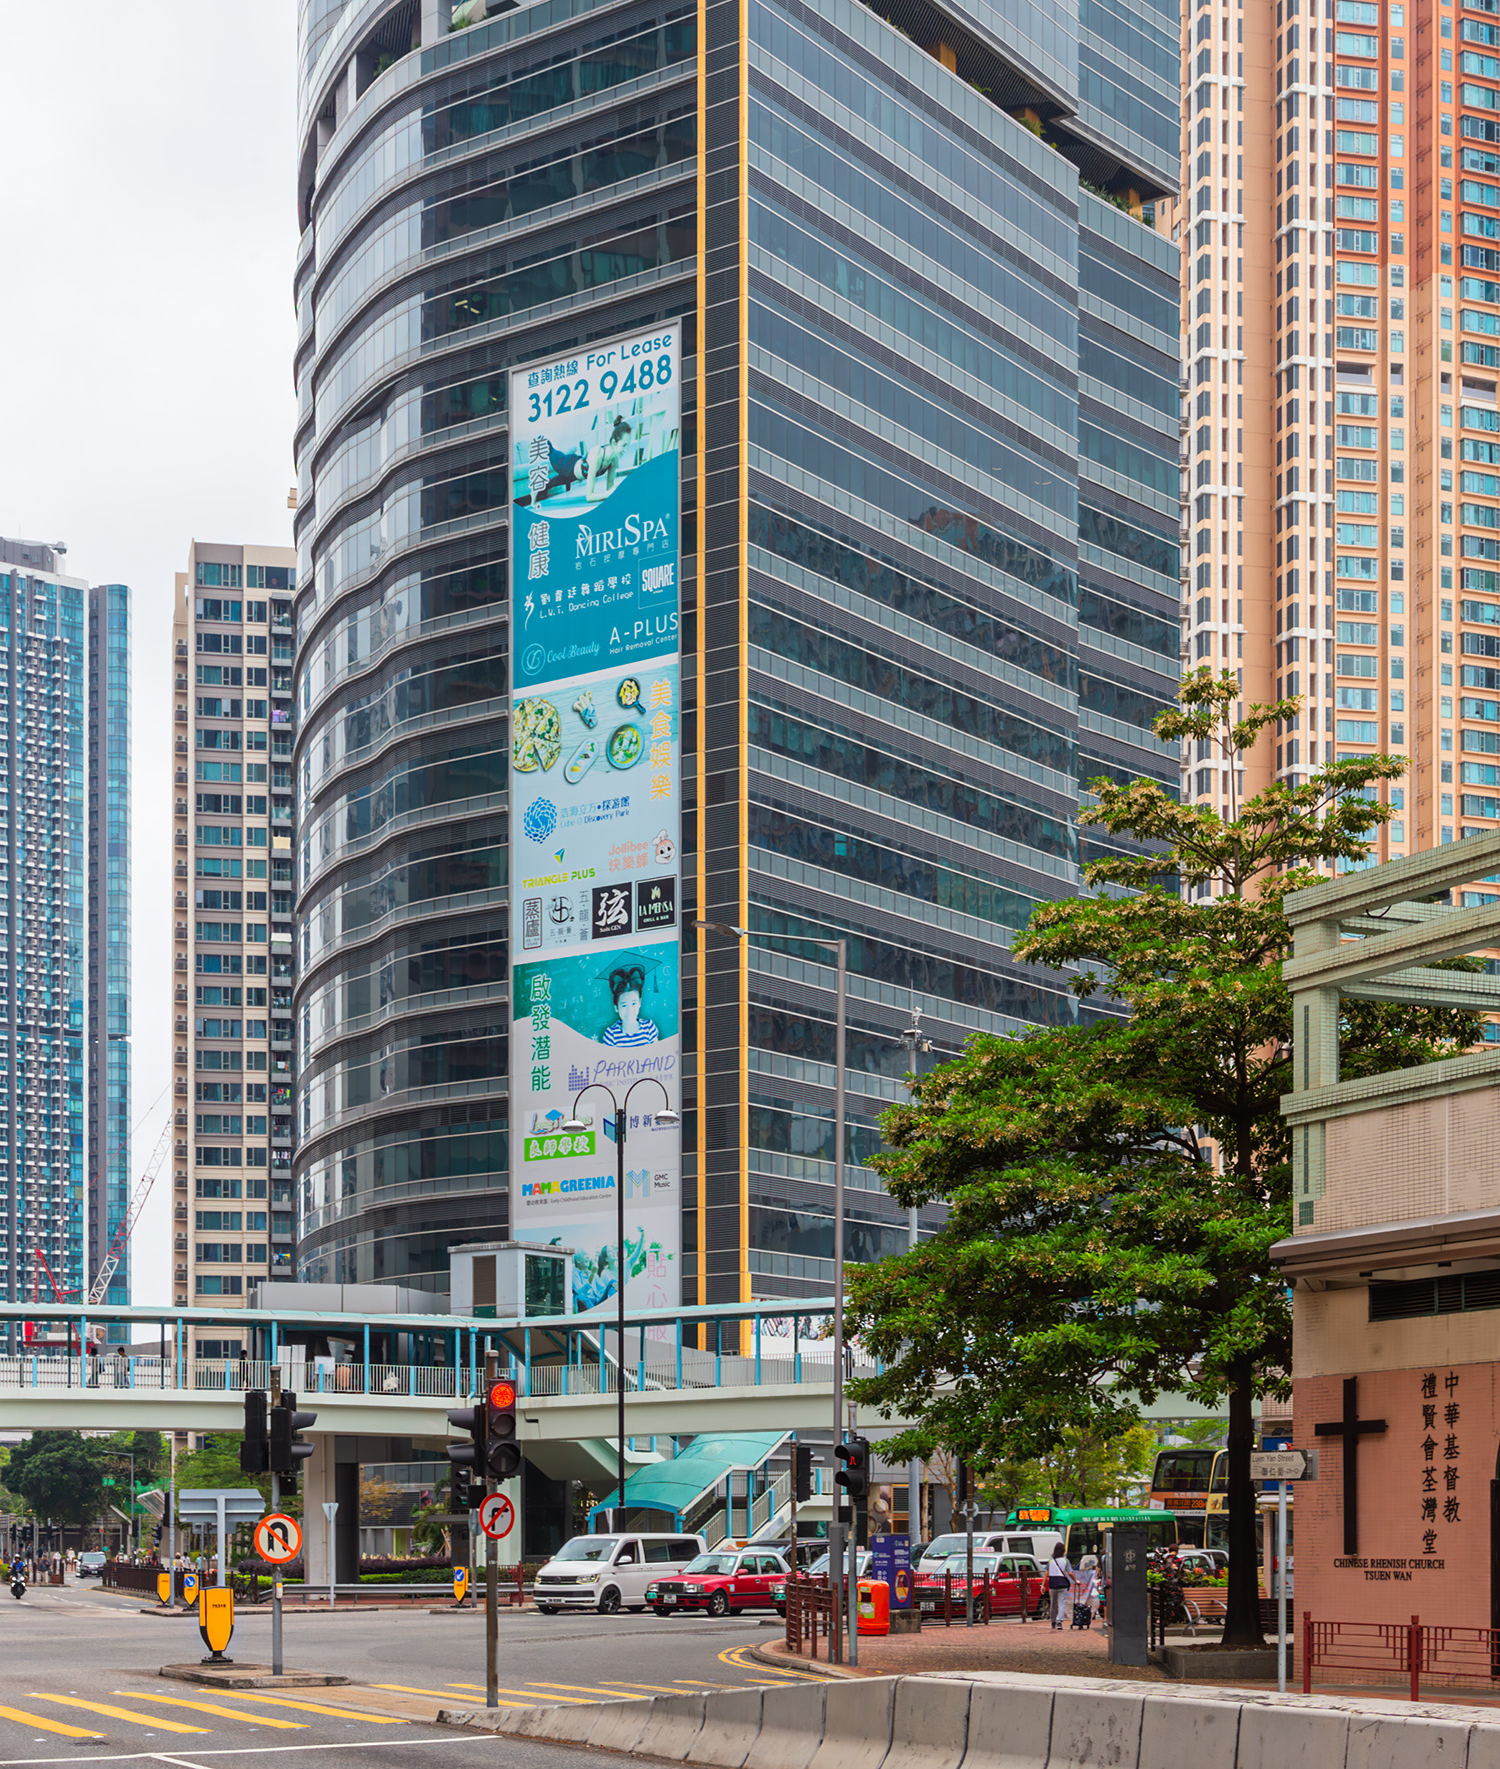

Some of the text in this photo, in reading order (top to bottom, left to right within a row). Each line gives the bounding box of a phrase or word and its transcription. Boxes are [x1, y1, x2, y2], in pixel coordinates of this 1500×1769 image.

[528, 334, 672, 388] 查詢熱線 For Lease
[528, 354, 672, 422] 3122 9488
[642, 563, 675, 592] SQUARE
[568, 599, 599, 612] Dancing
[602, 591, 634, 604] College
[609, 634, 678, 655] Hair Removal Center
[650, 678, 672, 801] 美食娛樂
[615, 808, 630, 818] Park
[608, 841, 649, 856] Jollibee
[608, 852, 649, 873] 快樂蜂
[522, 867, 596, 889] TRIANGLE PLUS
[594, 888, 630, 926] 弦
[530, 974, 551, 1092] 啟發潛能
[593, 1054, 676, 1083] PARKLAND
[522, 1175, 616, 1197] MAMAGREENIA
[654, 1173, 669, 1181] GMC
[654, 1181, 671, 1189] Music
[1442, 1370, 1462, 1523] 中華基督教
[1252, 1454, 1294, 1463] Luen Yan Street
[1420, 1372, 1439, 1555] 禮賢會荃灣堂
[1333, 1558, 1445, 1570] CHINESE RHENISH CHURCH
[1364, 1570, 1413, 1581] TSUEN WAN
